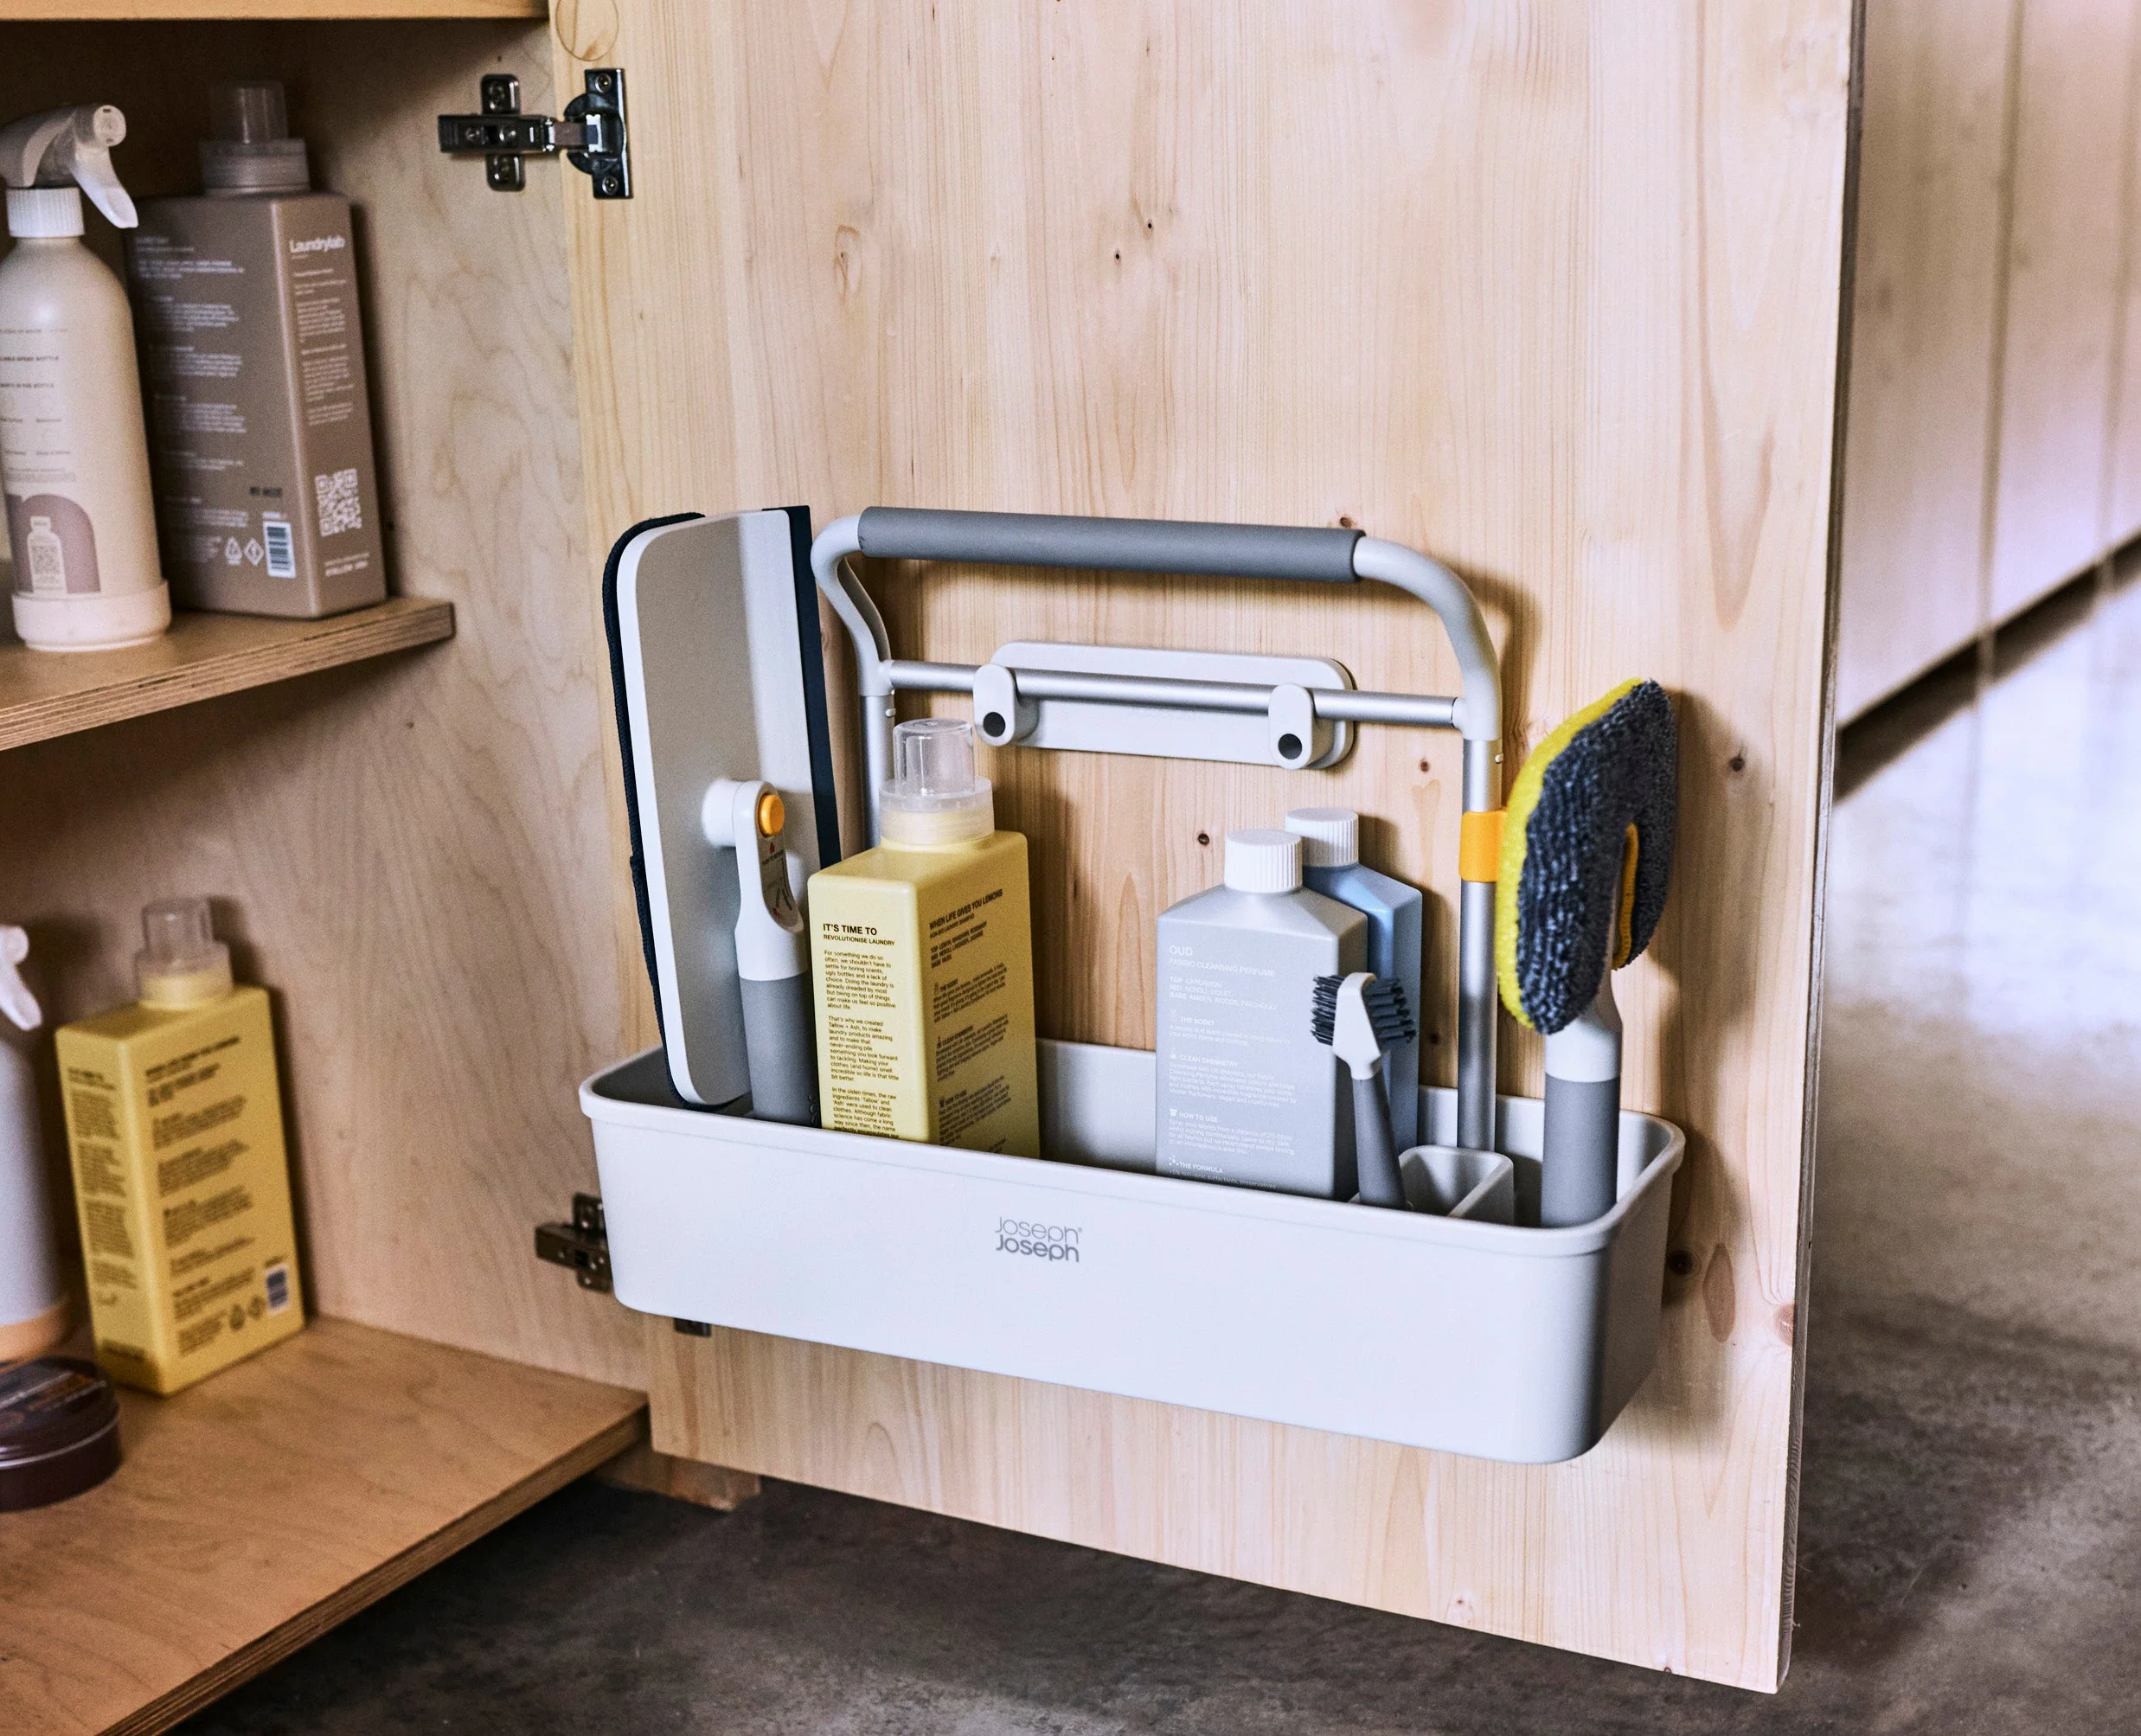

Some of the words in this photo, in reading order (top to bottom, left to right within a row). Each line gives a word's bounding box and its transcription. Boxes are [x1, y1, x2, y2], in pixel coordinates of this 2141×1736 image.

[929, 916, 945, 930] WHEN
[946, 911, 957, 923] LIFE
[957, 905, 971, 917] GIVES
[972, 900, 982, 910] YOU
[983, 889, 1003, 905] LEMONS
[842, 925, 862, 934] TIME
[824, 934, 867, 943] REVOLUTIONISE
[1170, 945, 1193, 956] OUD
[1196, 961, 1238, 972] CLEANSING
[1240, 966, 1275, 977] PERFUME
[1193, 1163, 1223, 1174] FORMULA
